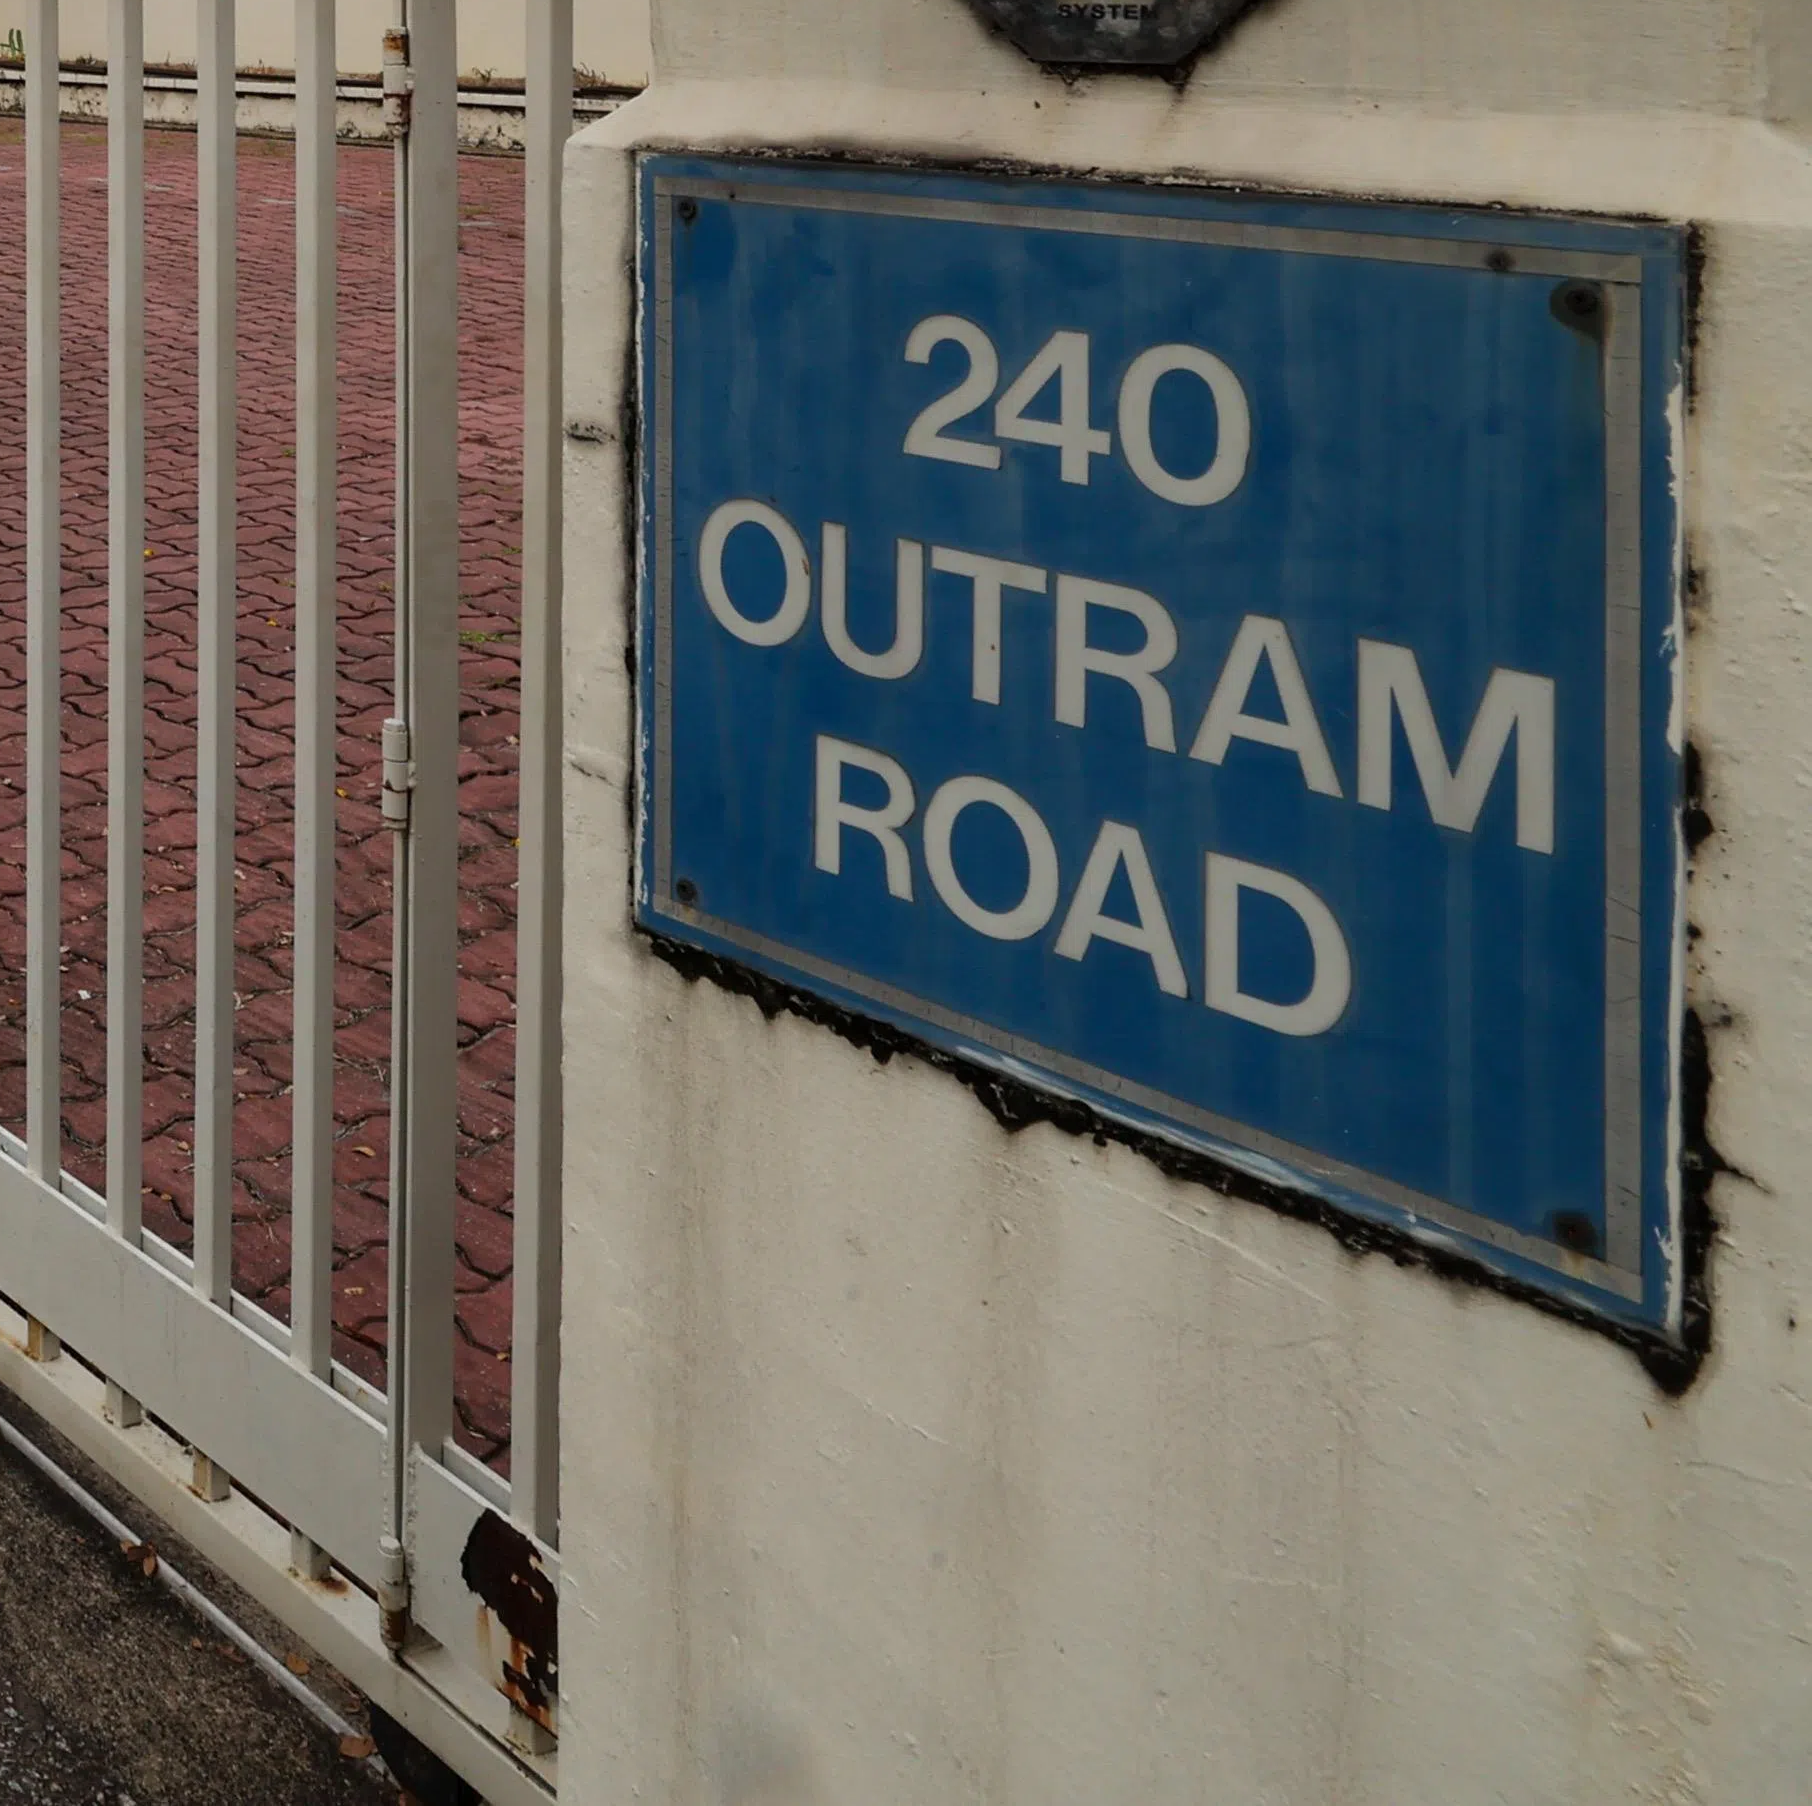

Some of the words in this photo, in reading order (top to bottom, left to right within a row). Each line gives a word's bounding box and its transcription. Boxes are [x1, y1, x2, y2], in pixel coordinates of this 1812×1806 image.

[1057, 3, 1161, 20] SYSTEM
[902, 313, 1252, 507] 240
[697, 498, 1556, 856] OUTRAM
[814, 733, 1353, 1037] ROAD
